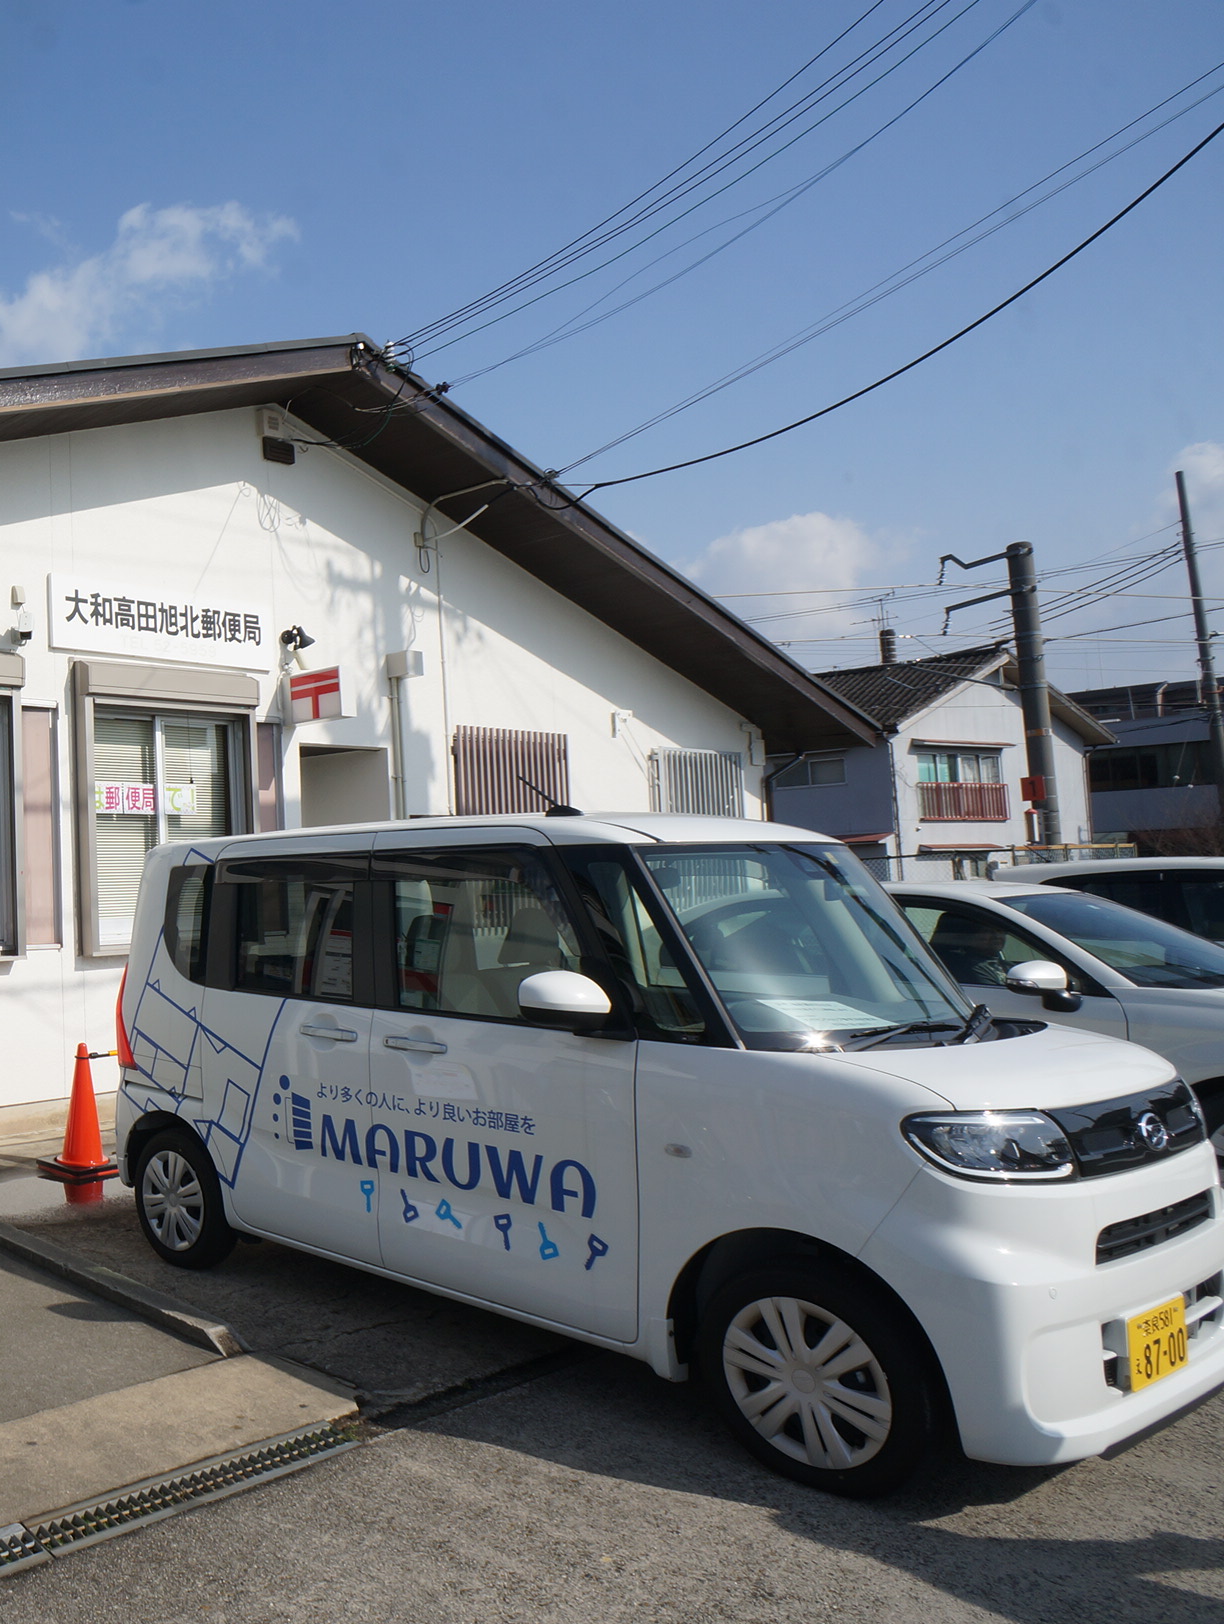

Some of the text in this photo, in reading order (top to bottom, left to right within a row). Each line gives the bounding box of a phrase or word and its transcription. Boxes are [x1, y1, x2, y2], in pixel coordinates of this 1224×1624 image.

[64, 588, 262, 647] 大和高田旭北郵便局
[317, 1082, 536, 1136] より多くの人に、より良いお部屋を
[320, 1113, 597, 1220] MARUWA
[1144, 1327, 1186, 1380] 87-00
